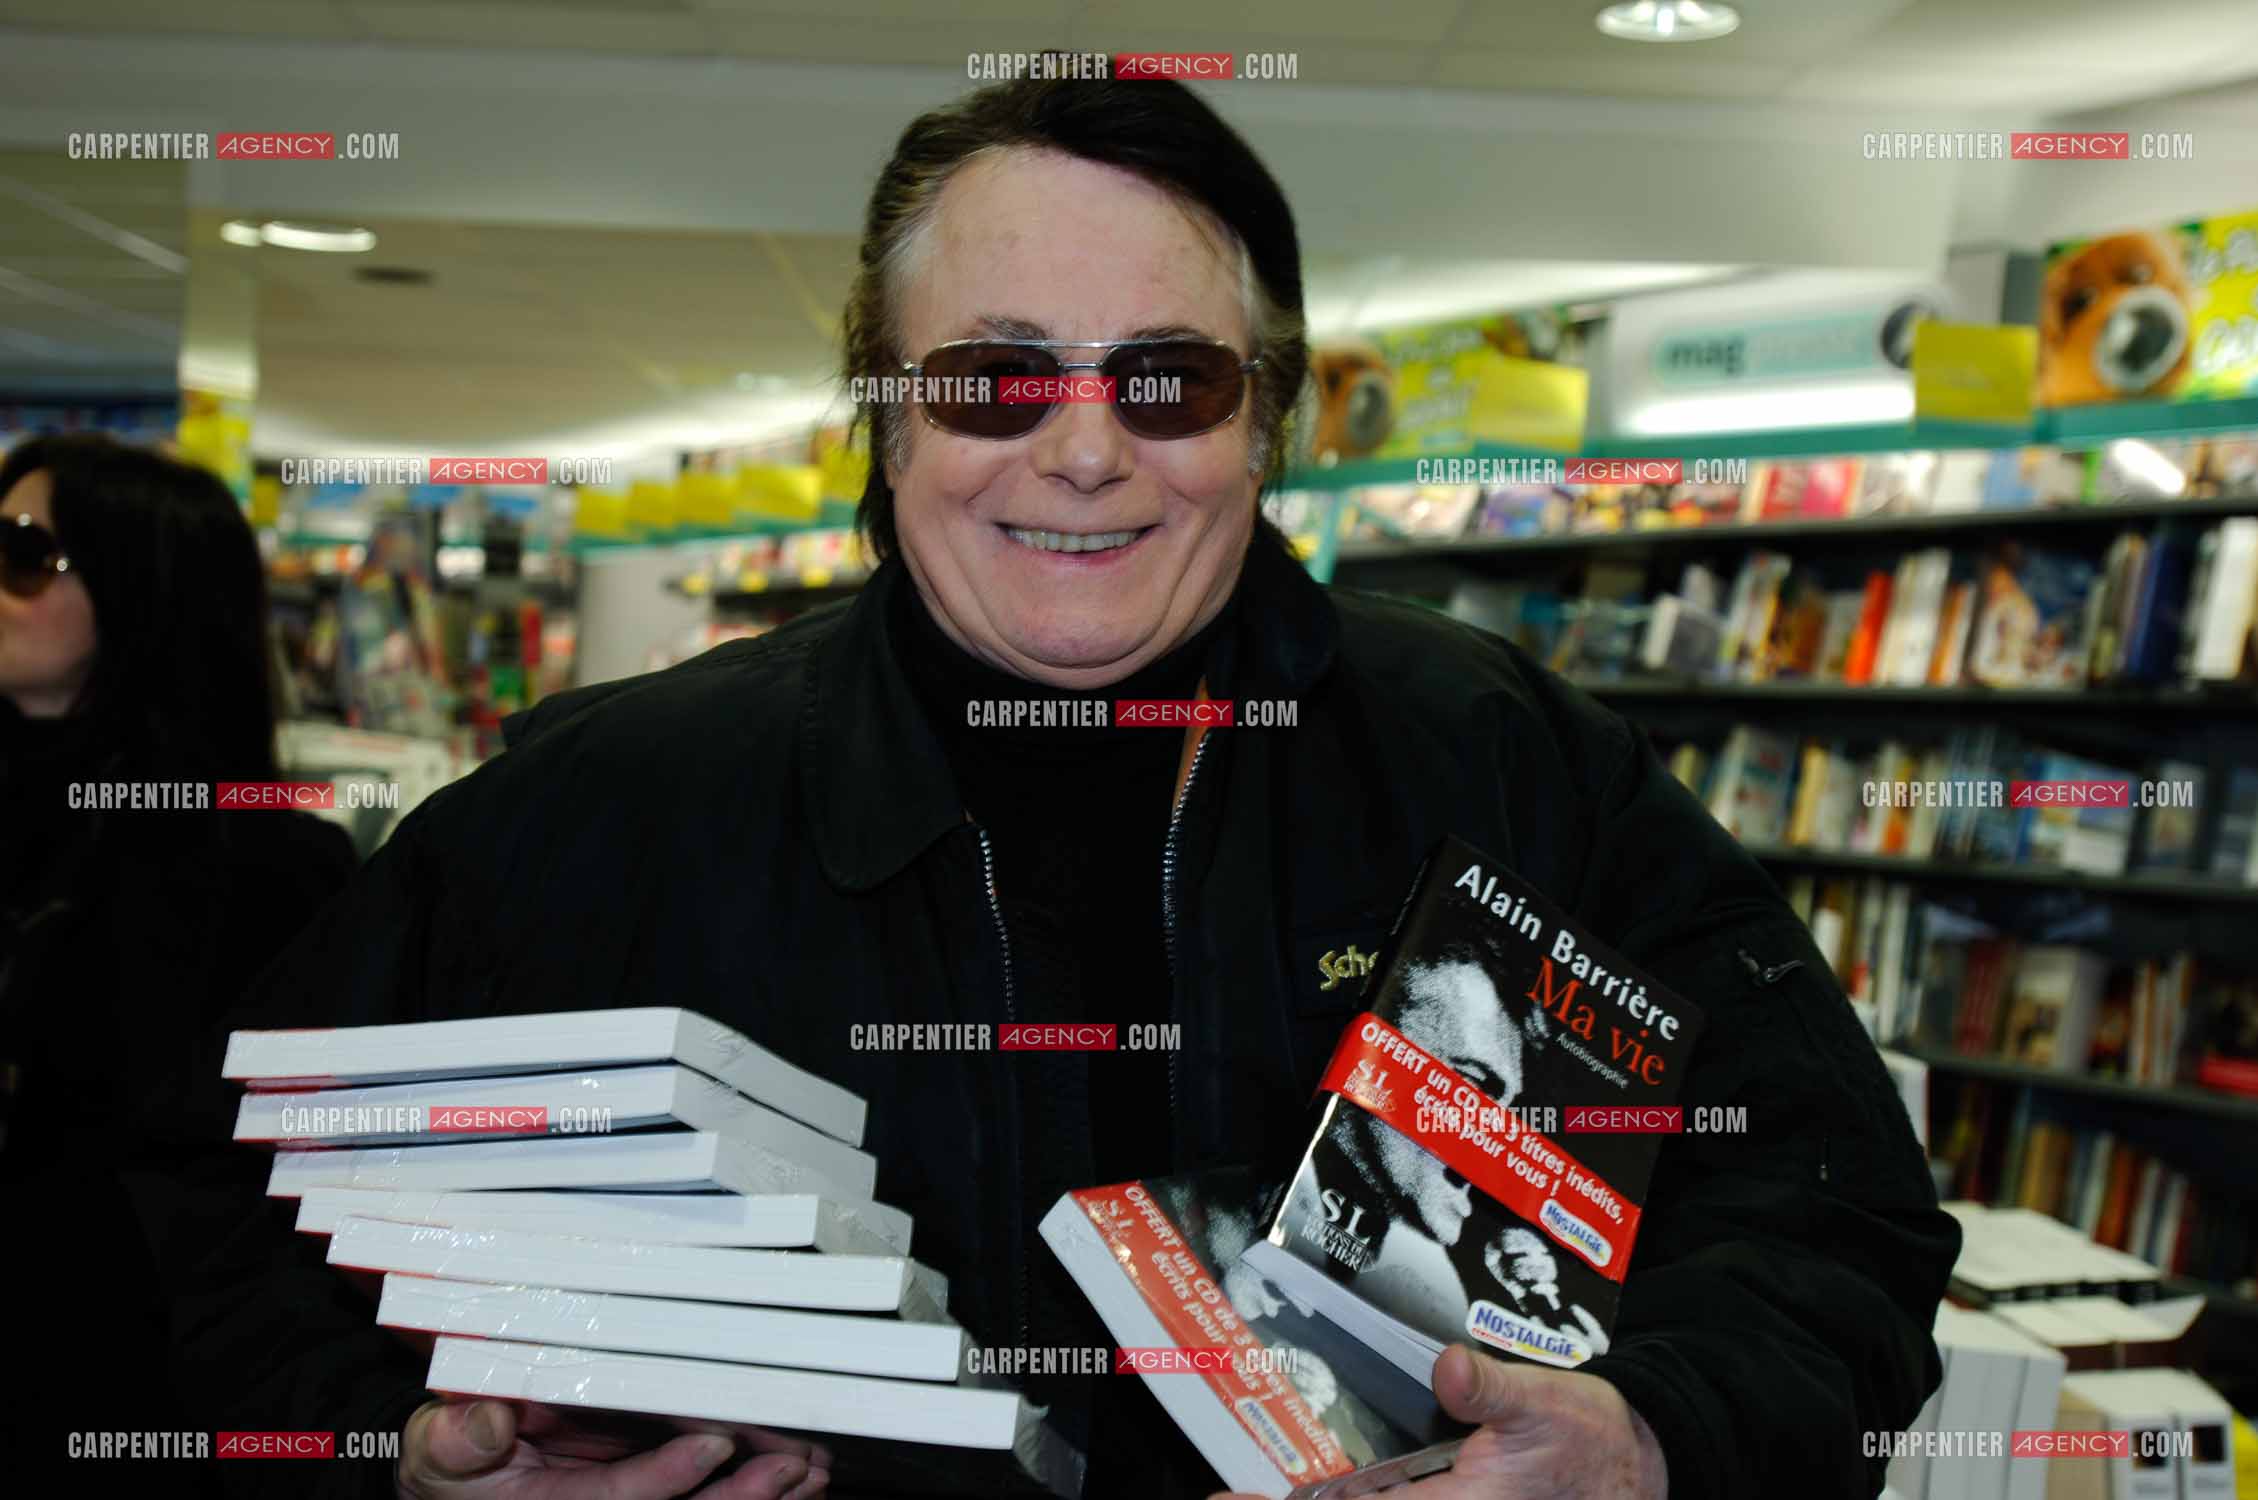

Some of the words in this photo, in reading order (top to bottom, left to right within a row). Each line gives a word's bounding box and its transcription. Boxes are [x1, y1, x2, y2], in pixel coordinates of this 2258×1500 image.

[1454, 864, 1542, 940] Alain
[1551, 929, 1680, 1041] Barrière
[1525, 955, 1596, 1040] Ma
[1610, 1026, 1665, 1085] vie
[1556, 1031, 1629, 1088] Autobiographie
[1360, 1021, 1430, 1075] OFFERT
[1427, 1068, 1452, 1095] un
[1453, 1085, 1480, 1113] CD
[1504, 1118, 1520, 1141] 3
[1520, 1134, 1566, 1175] titres
[1565, 1165, 1623, 1224] inédits,
[1459, 1122, 1506, 1158] pour
[1506, 1151, 1549, 1189] vous
[1550, 1178, 1561, 1197] !
[1124, 1185, 1182, 1247] OFFERT
[1172, 1250, 1197, 1276] un
[1193, 1277, 1221, 1304] CD
[1214, 1306, 1239, 1331] de
[1232, 1333, 1253, 1345] 3
[1151, 1251, 1193, 1300] écrits
[1182, 1301, 1227, 1344] pour
